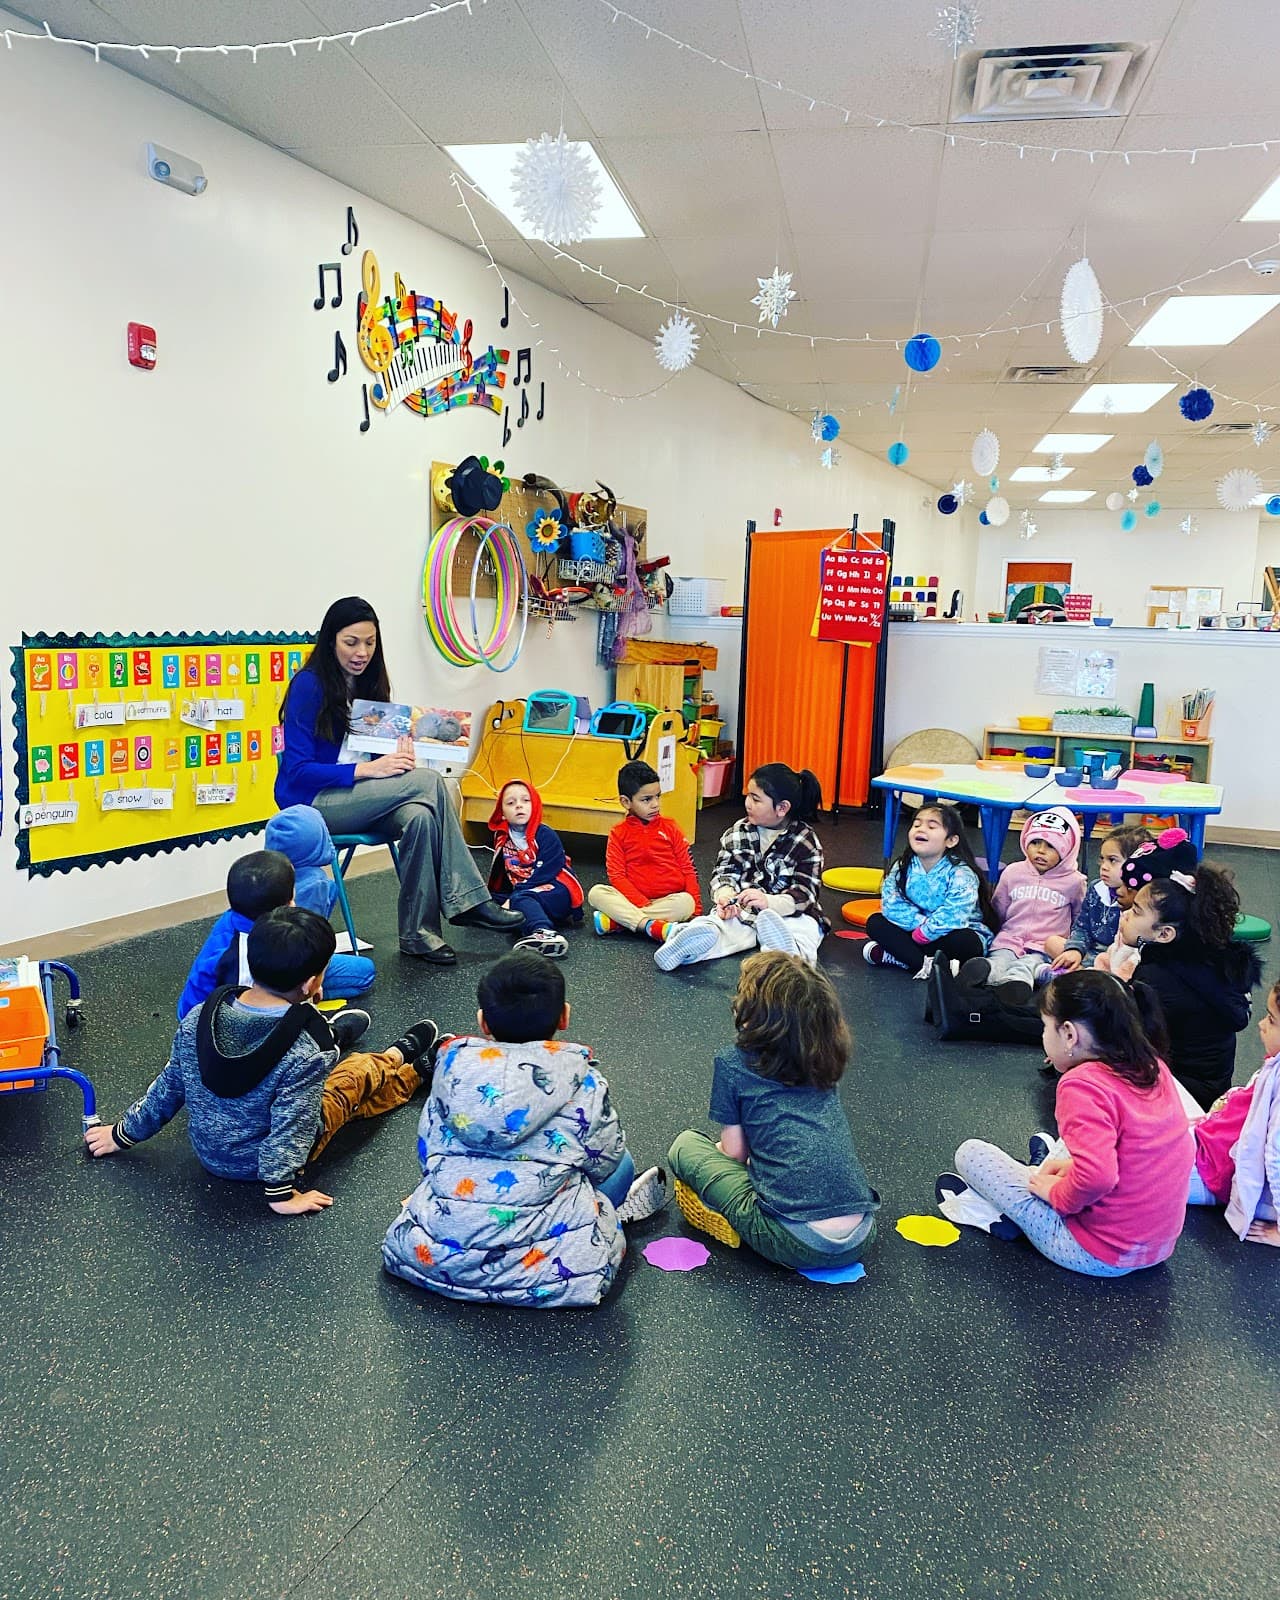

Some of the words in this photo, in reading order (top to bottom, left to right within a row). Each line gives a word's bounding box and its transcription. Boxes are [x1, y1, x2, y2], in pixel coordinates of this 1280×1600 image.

[862, 557, 873, 565] Dd
[837, 570, 847, 579] Gg
[823, 598, 832, 607] Pp
[834, 599, 845, 608] Qq
[94, 710, 113, 719] cold
[118, 795, 142, 804] snow
[35, 809, 74, 820] penguin
